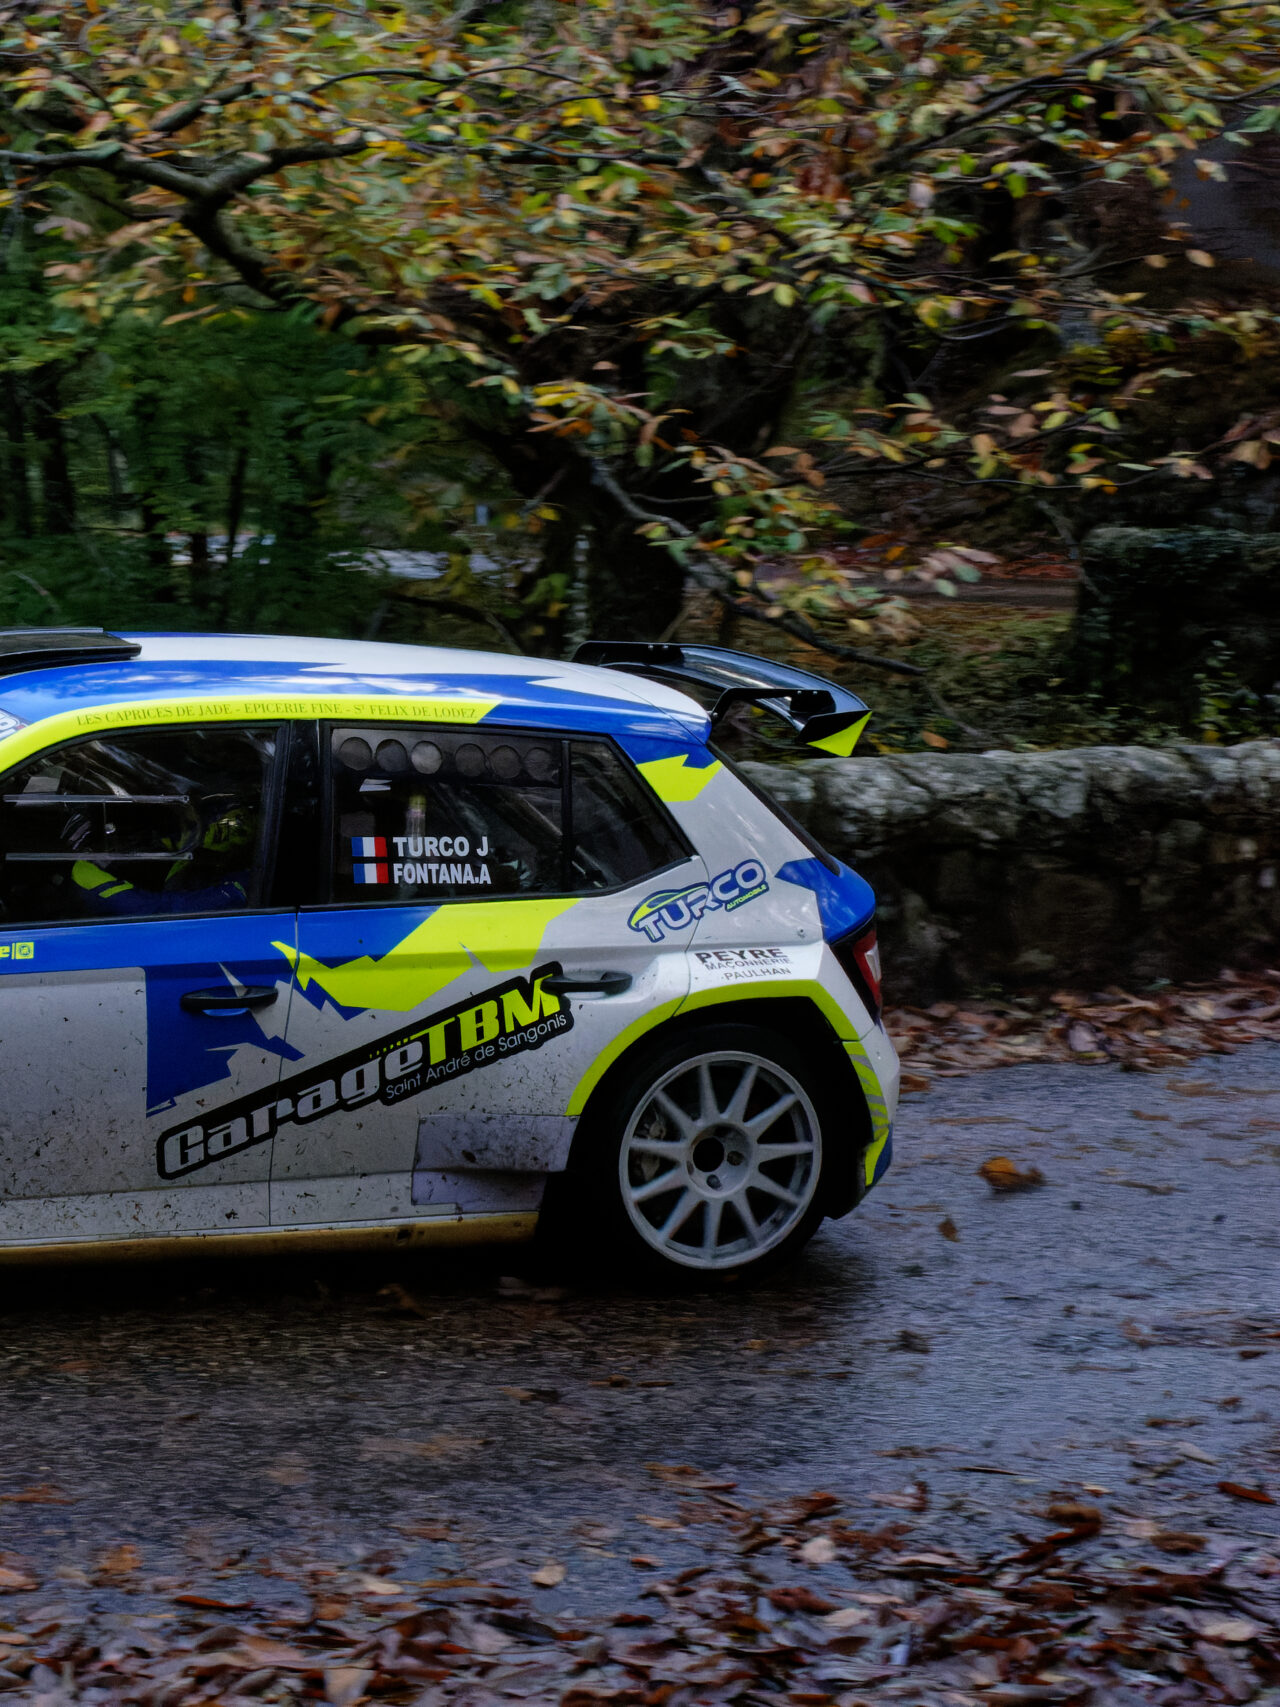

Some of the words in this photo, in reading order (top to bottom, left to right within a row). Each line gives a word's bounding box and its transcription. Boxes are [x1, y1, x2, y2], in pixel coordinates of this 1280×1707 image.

[77, 715, 102, 727] LES
[105, 707, 171, 723] CAPRICES
[176, 705, 194, 717] DE
[199, 704, 232, 717] JADE
[245, 703, 307, 714] EPICERIE
[312, 704, 343, 714] FINE
[370, 705, 408, 717] FELIX
[412, 706, 431, 717] DE
[434, 708, 477, 719] LODEZ
[393, 836, 470, 857] TURCO
[476, 836, 489, 857] J
[393, 863, 492, 884] FONTANA.A
[637, 861, 764, 941] TURCO
[695, 948, 788, 964] PEYRE
[704, 959, 793, 970] MAÇONNERIE
[385, 1073, 421, 1099] Saint
[426, 1052, 471, 1083] André
[474, 1043, 495, 1061] de
[498, 1013, 567, 1052] Sangonis
